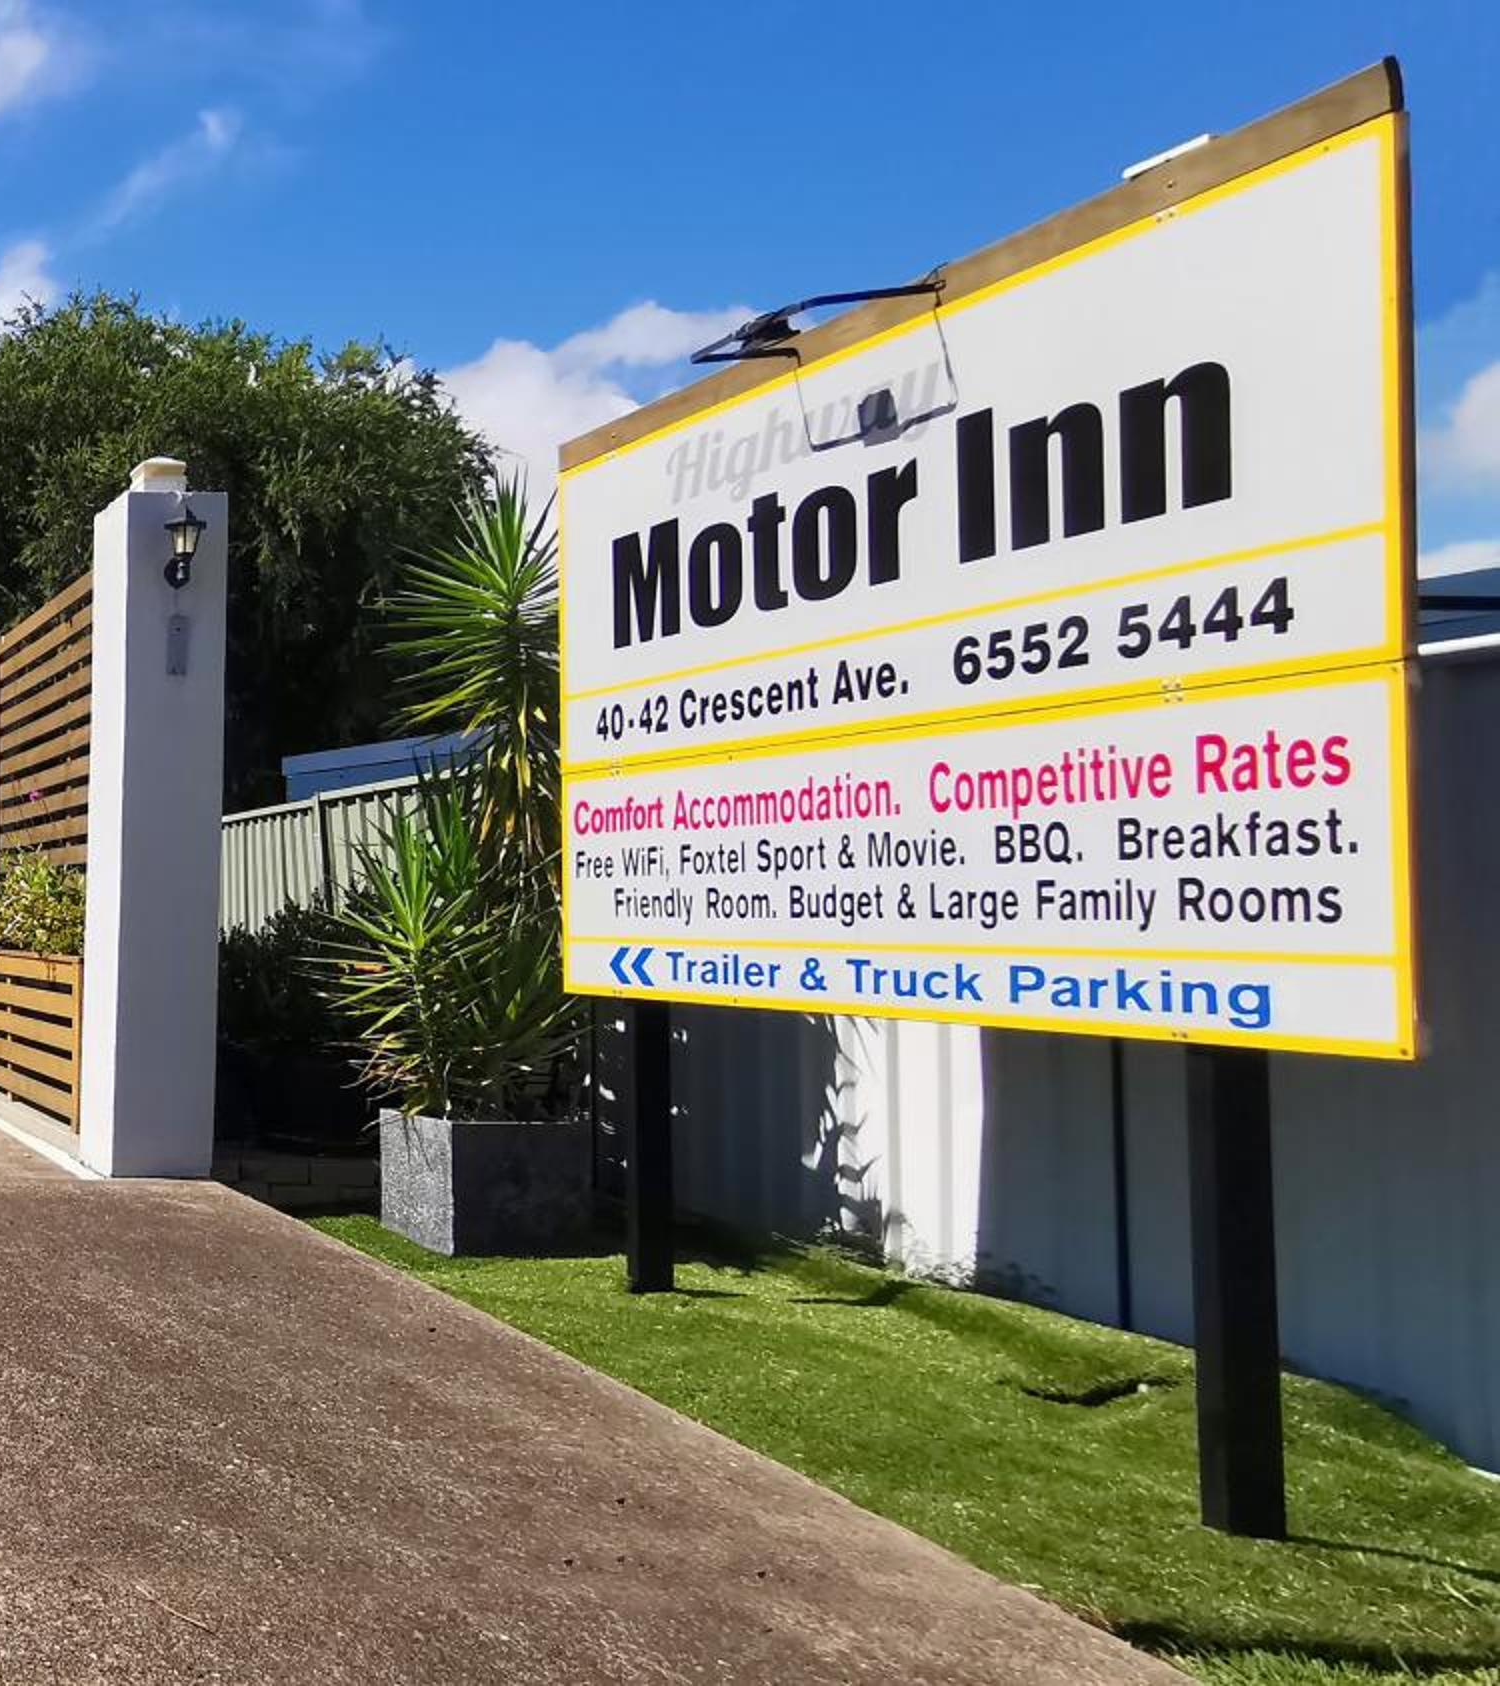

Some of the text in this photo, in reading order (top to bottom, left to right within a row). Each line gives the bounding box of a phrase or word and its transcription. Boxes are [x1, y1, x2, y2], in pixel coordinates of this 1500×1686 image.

[612, 362, 1232, 650] Motor Inn
[596, 577, 1295, 741] 40-42 Crescent Ave. 6552 5444
[573, 730, 1352, 835] Comfort Accommodation. Competitive Rates
[575, 808, 1359, 880] Free WiFi, Foxtel Sport & Movie. BBQ. Breakfast.
[614, 876, 1343, 932] Friendly Room. Budget & Large Family Rooms
[665, 950, 1272, 1030] Trailer & Truck Parking
